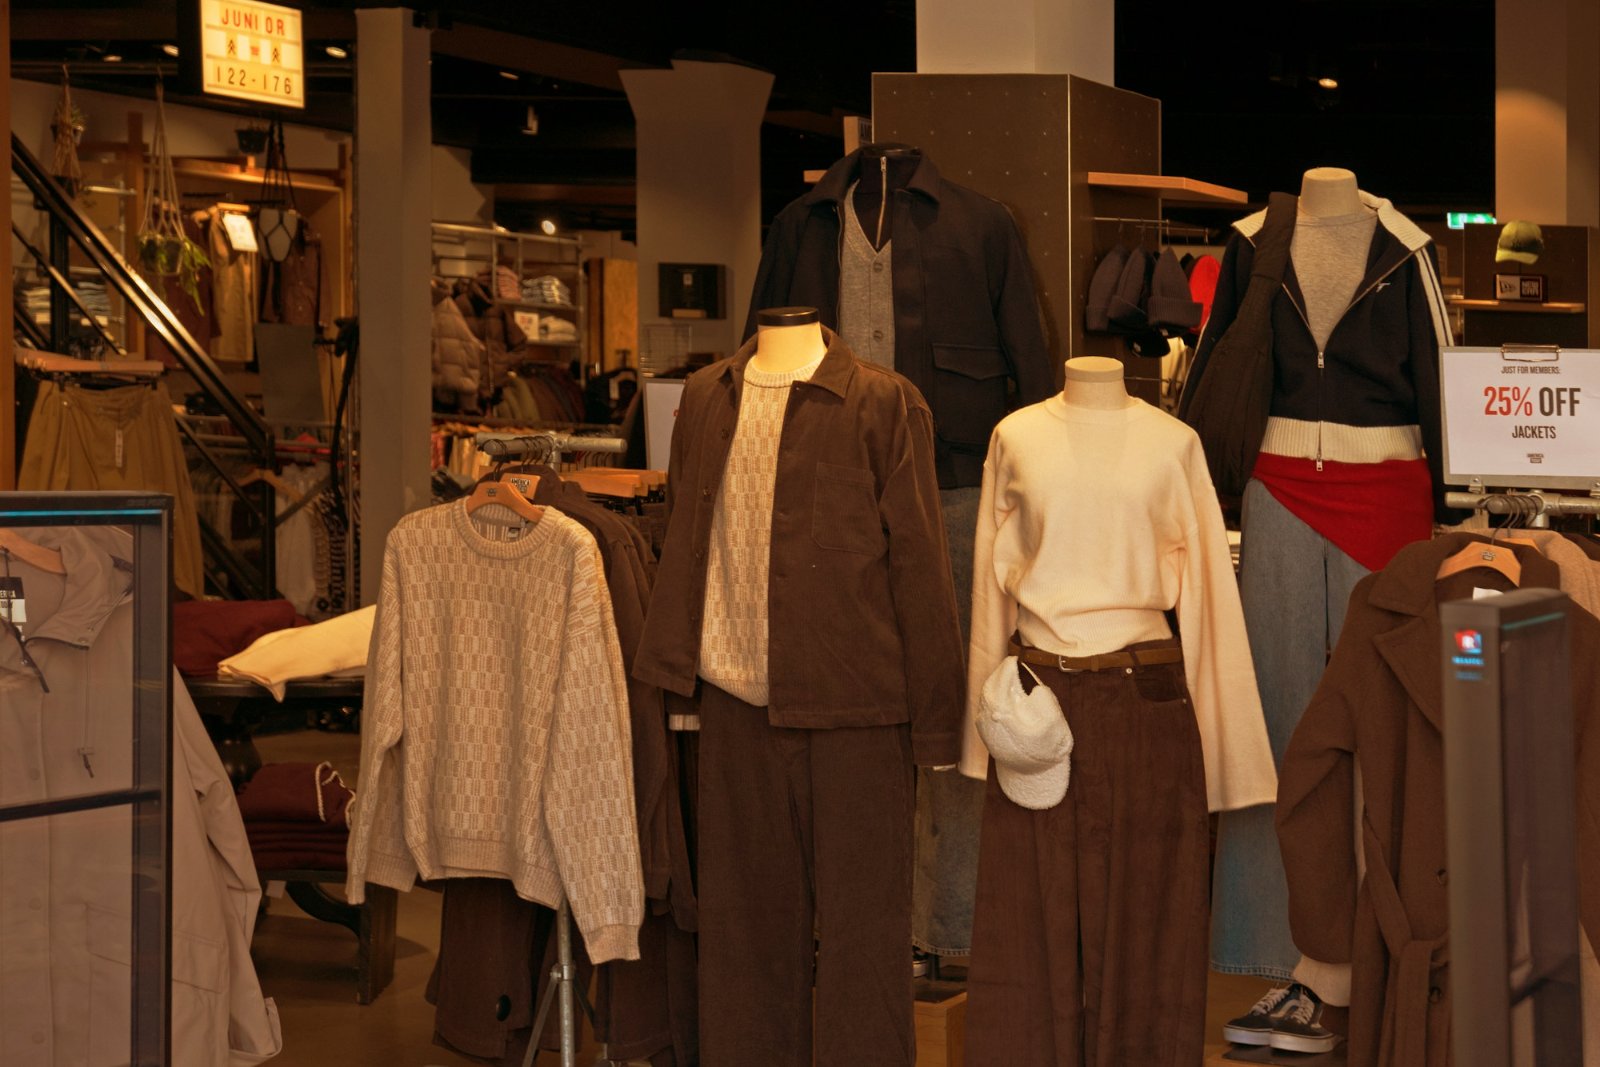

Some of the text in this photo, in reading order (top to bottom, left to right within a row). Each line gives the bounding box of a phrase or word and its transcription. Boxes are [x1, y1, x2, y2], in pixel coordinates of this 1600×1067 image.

[222, 8, 285, 36] JUNIOR
[1501, 366, 1516, 374] JUST
[1517, 366, 1529, 374] FOR
[1483, 386, 1582, 417] 25% OFF
[1512, 425, 1557, 440] JACKETS
